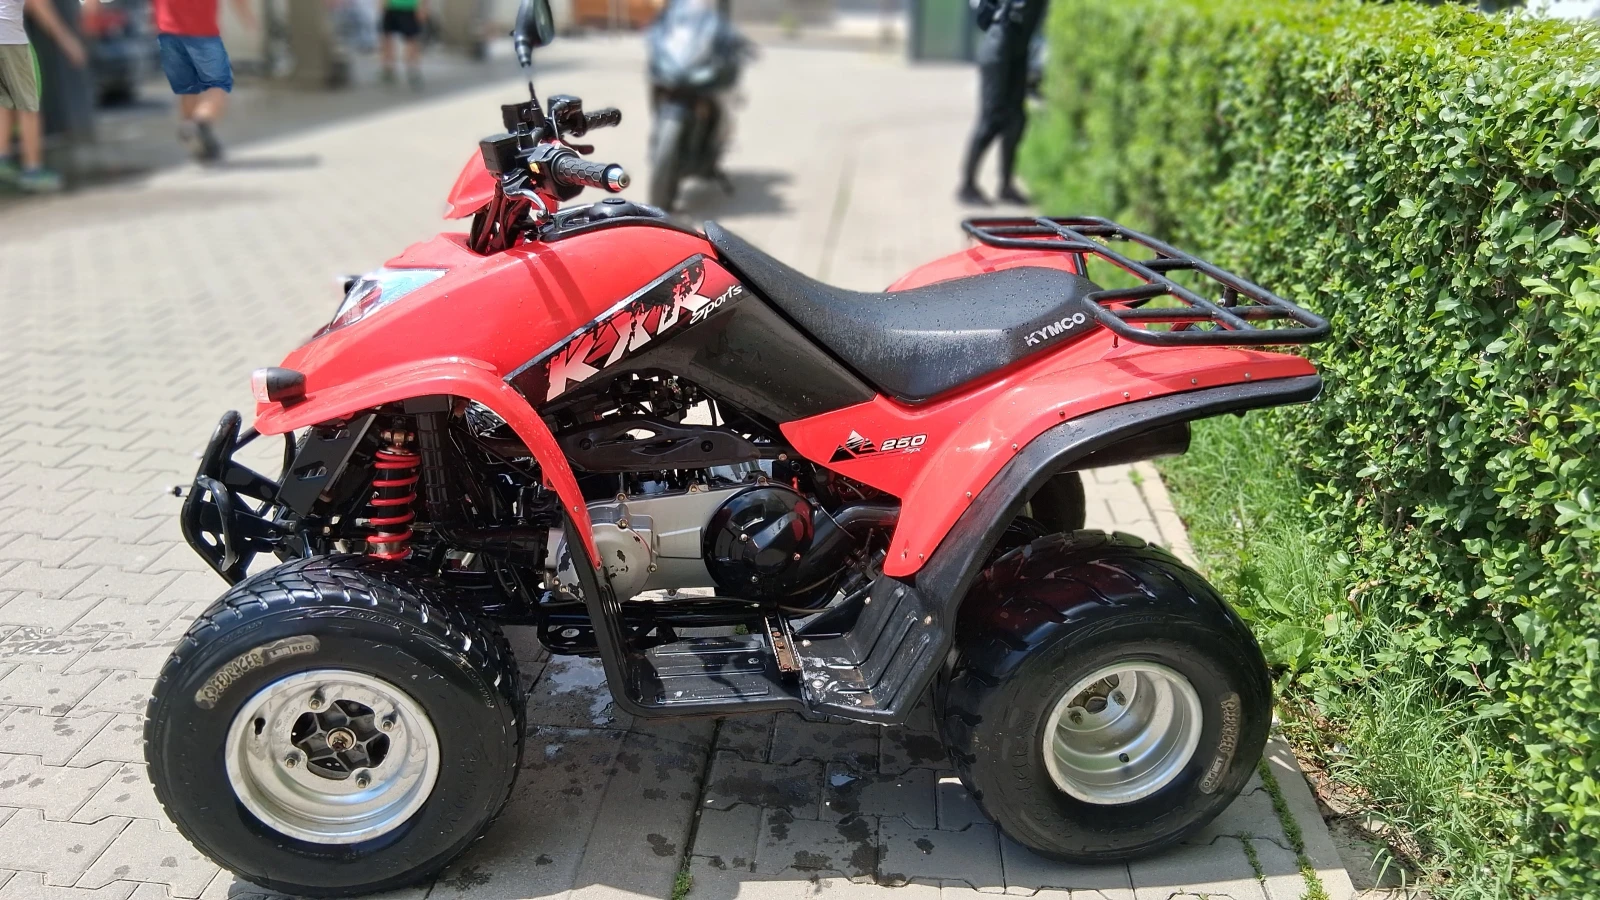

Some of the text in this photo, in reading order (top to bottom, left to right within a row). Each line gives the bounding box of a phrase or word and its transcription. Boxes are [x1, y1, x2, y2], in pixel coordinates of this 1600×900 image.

[546, 262, 710, 402] KXR
[1023, 312, 1086, 347] KYMCO
[880, 433, 927, 452] 250
[202, 651, 264, 702] SPEEDRACER
